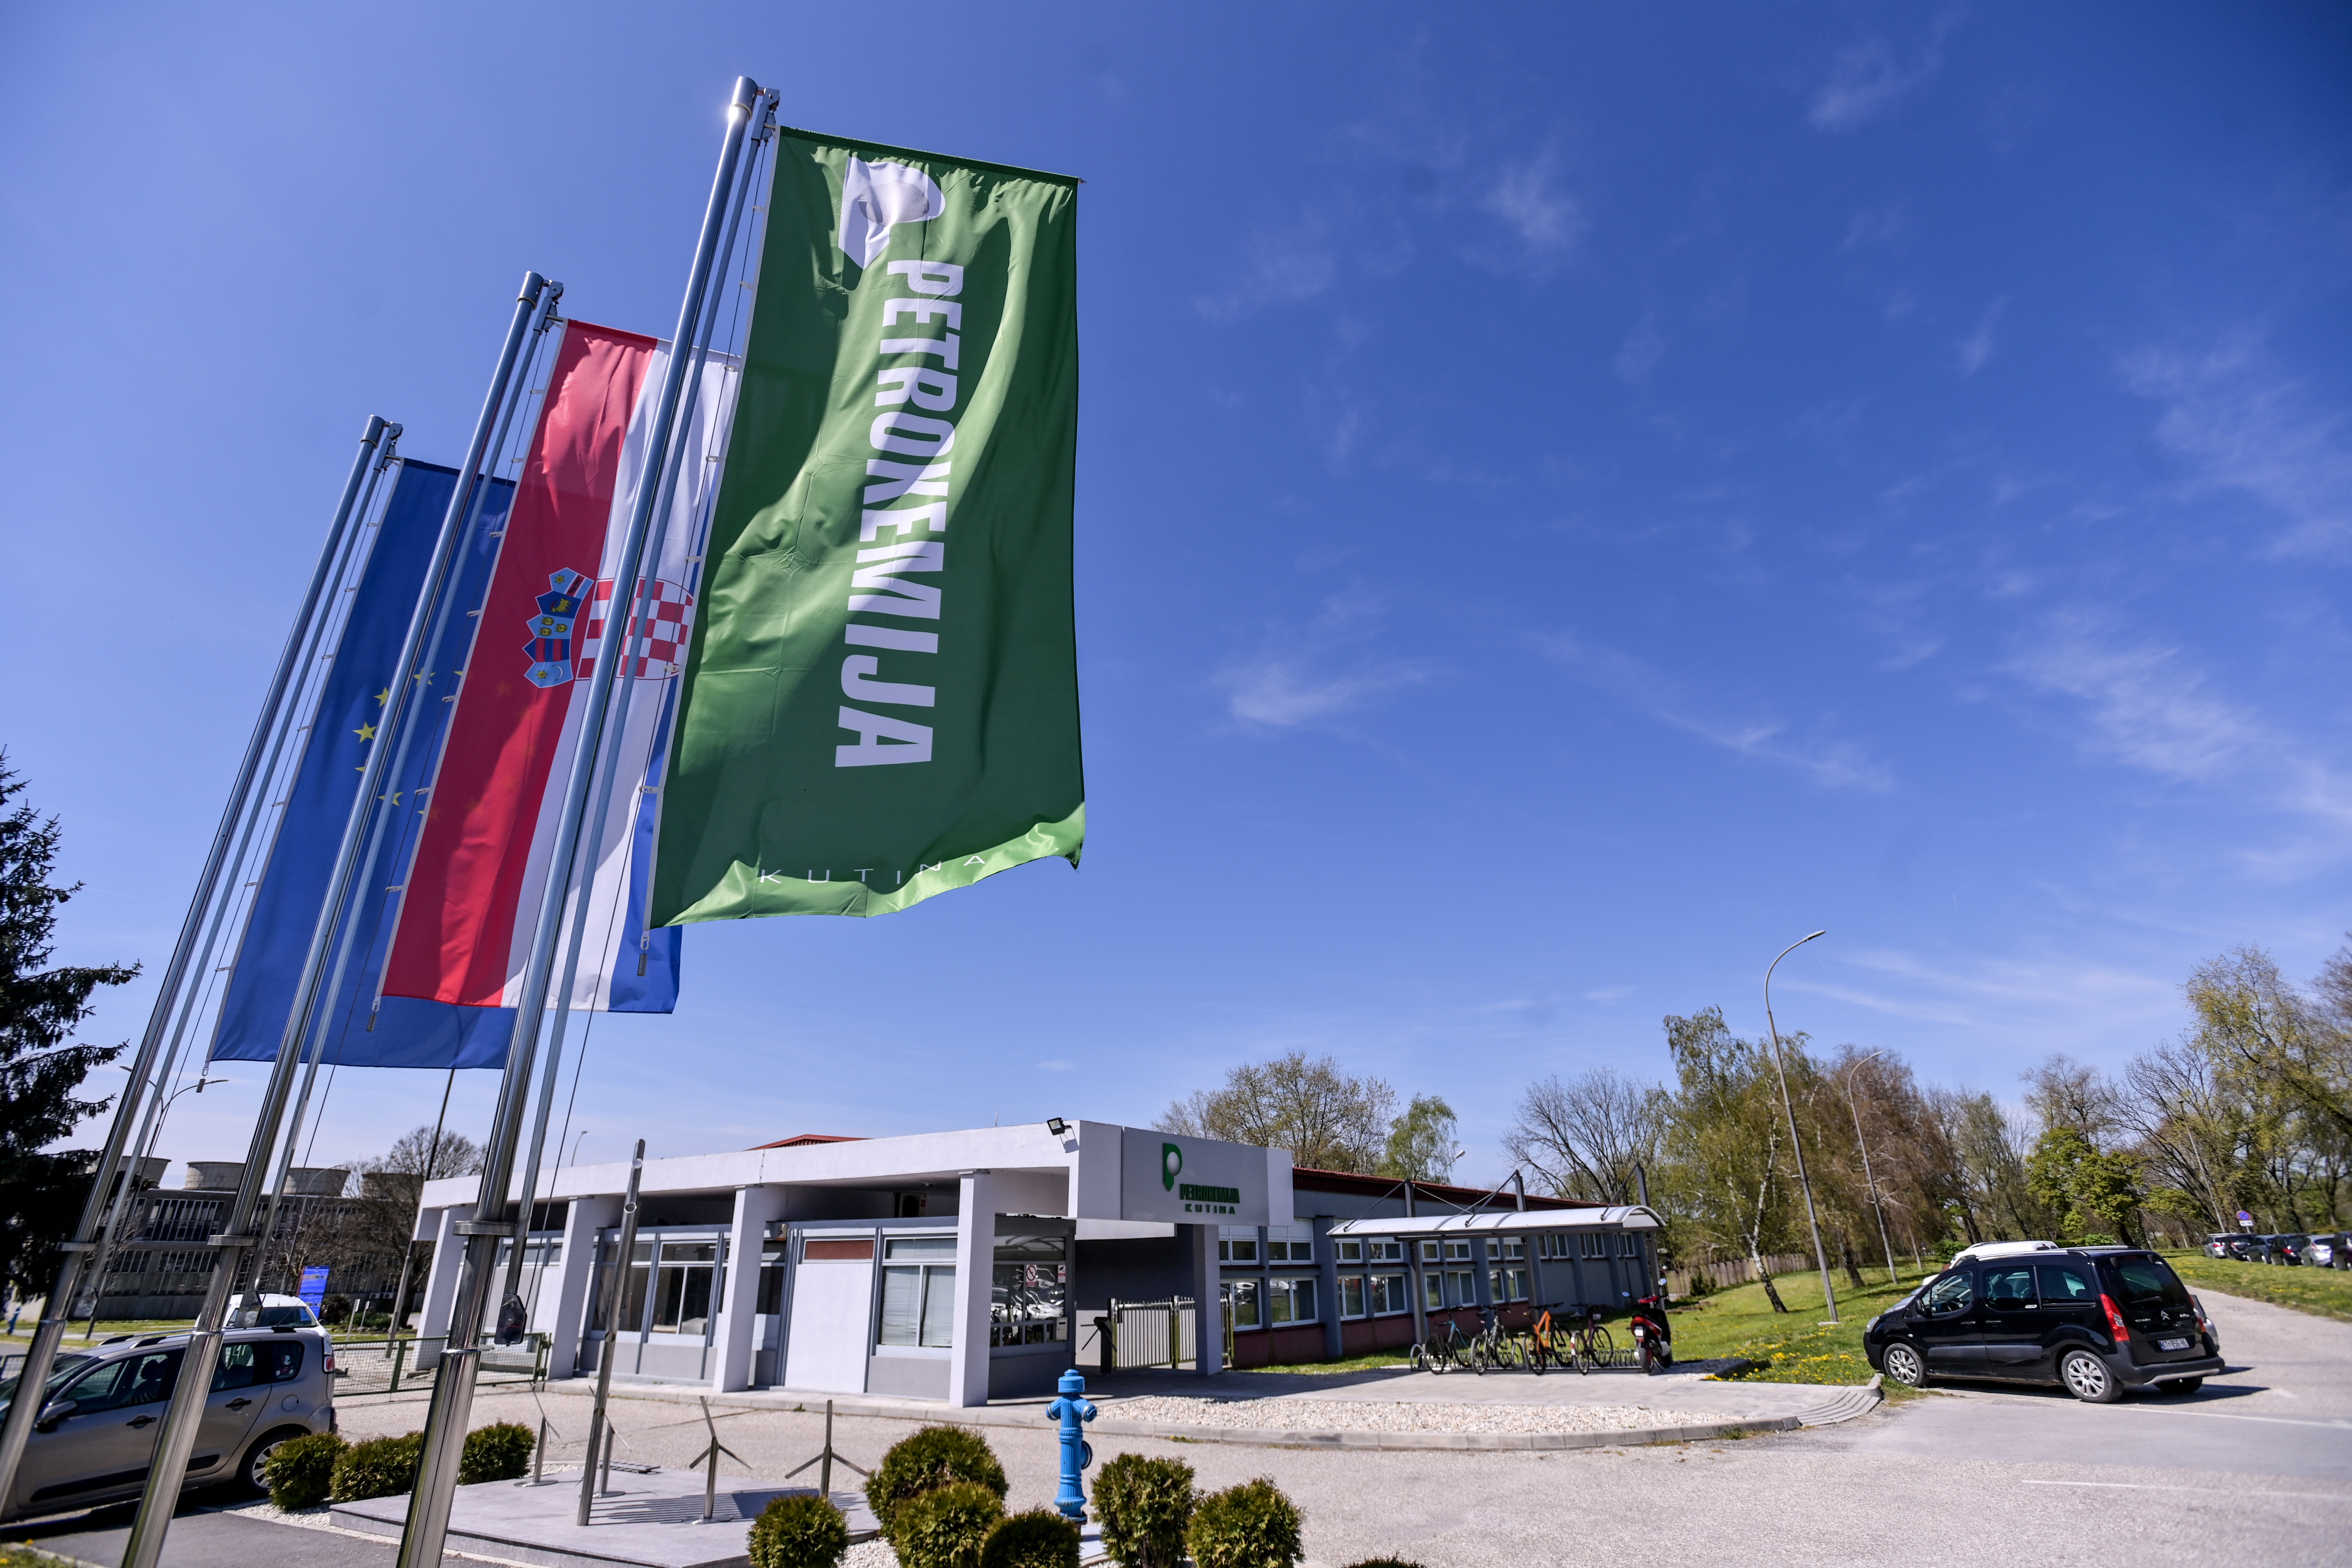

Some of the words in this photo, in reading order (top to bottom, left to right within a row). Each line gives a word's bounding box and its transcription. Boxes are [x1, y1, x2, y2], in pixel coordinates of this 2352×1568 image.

[835, 259, 964, 768] PETROKEMIJA
[760, 855, 985, 884] KUTINA
[1180, 1184, 1240, 1203] PETROKEMIJA
[1185, 1203, 1236, 1214] KUTINA
